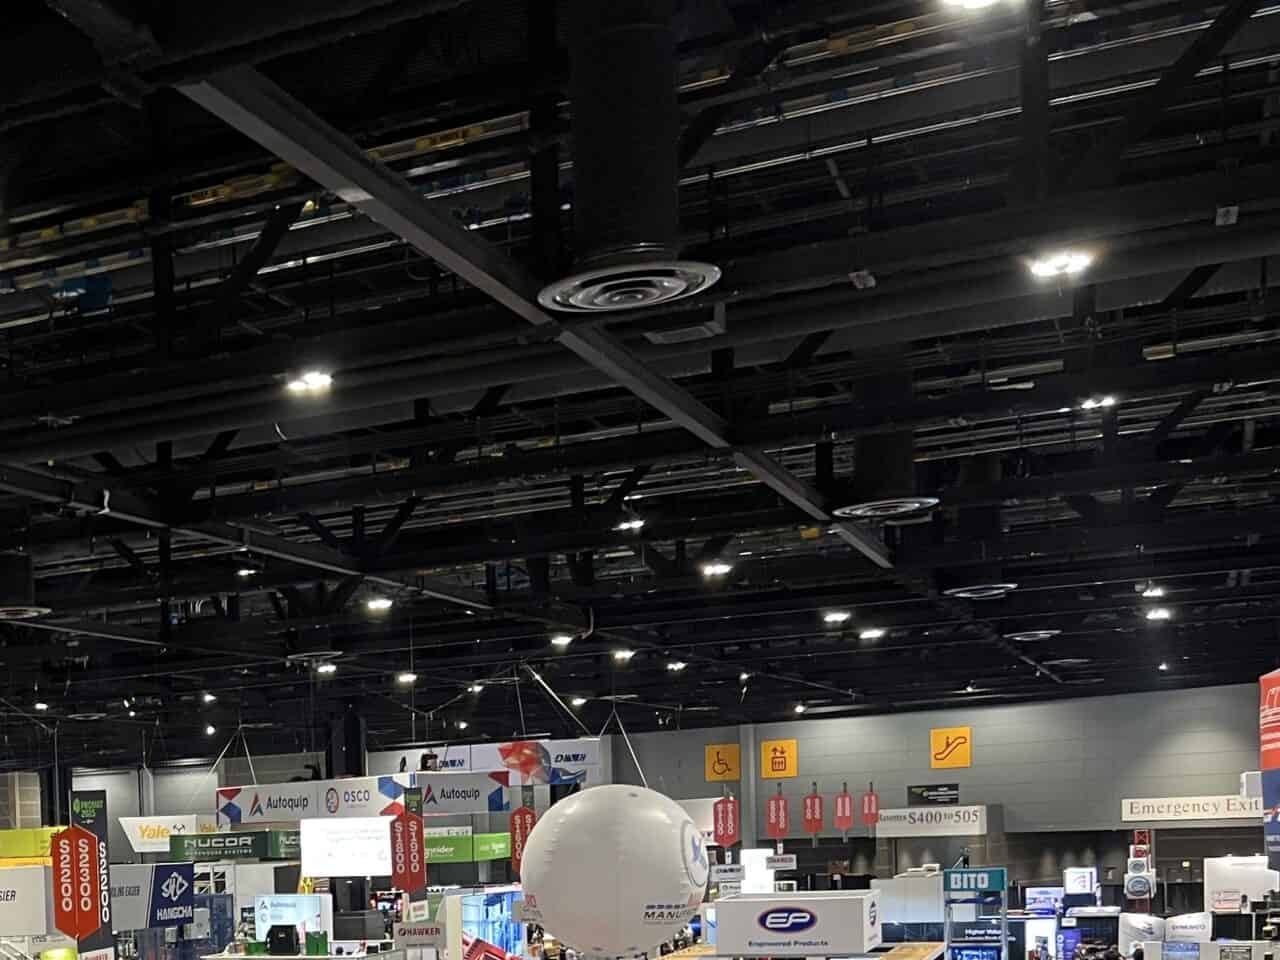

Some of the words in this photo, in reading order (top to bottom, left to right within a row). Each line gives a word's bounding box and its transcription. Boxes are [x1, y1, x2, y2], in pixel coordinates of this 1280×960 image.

[343, 790, 370, 802] OSCO
[440, 787, 480, 801] Autoquip
[266, 795, 309, 811] Autoquip
[1129, 800, 1220, 817] Emergency
[1226, 797, 1260, 812] Exit
[908, 811, 942, 825] S400
[954, 809, 980, 823] 505
[138, 825, 169, 840] Yale
[184, 836, 253, 848] NUCOR
[393, 821, 405, 873] S1800
[407, 820, 420, 873] S1900
[59, 838, 73, 912] S2200
[78, 837, 92, 912] S2300
[99, 841, 111, 923] S2200
[950, 873, 989, 889] BITO
[406, 927, 441, 936] HAWKER
